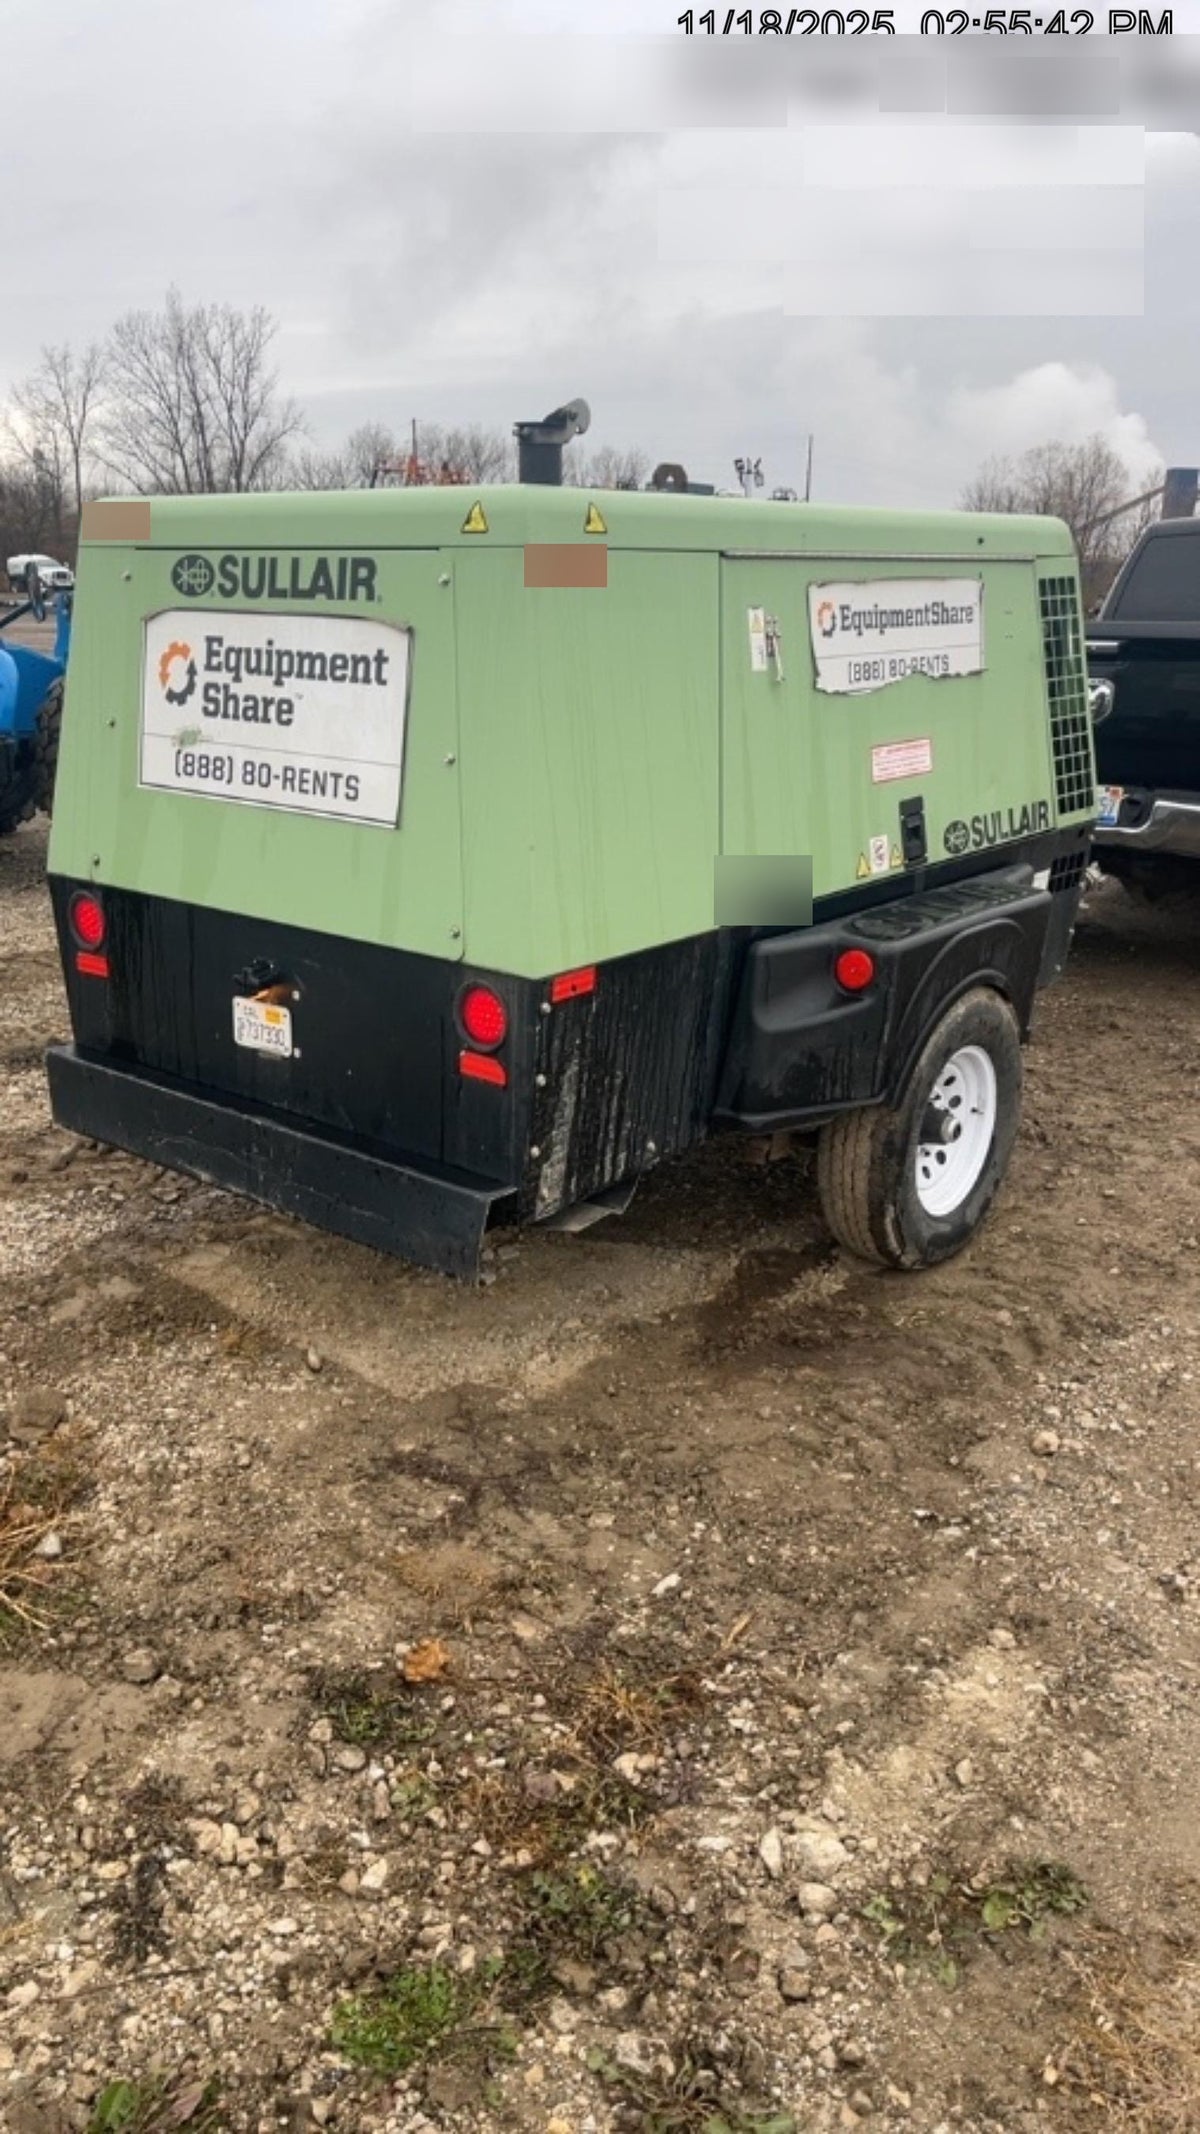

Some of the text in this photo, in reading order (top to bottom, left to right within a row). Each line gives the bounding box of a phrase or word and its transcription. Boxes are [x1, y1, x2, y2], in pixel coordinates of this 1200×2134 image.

[217, 554, 378, 602] SULLAIR
[839, 601, 974, 635] EquipmentShare
[203, 634, 390, 687] Equipment
[201, 681, 295, 726] Share
[174, 749, 360, 802] (888) 80-RENTS
[971, 799, 1049, 848] SULLAIR
